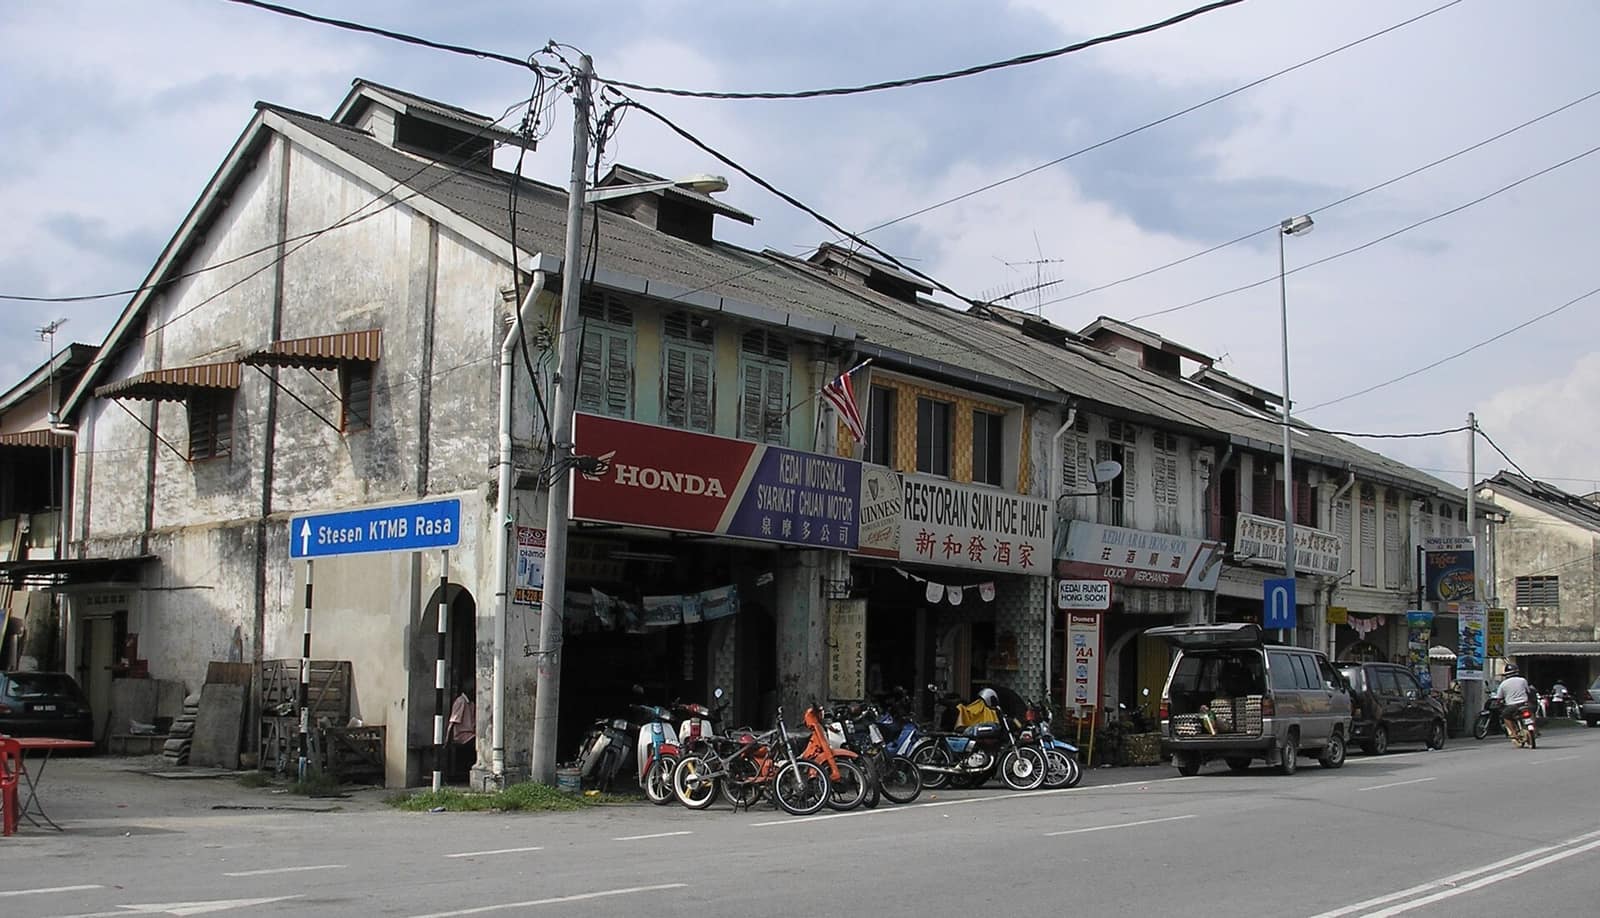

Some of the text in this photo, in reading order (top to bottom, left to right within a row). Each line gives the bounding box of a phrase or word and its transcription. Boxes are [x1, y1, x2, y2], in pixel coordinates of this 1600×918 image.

[614, 463, 726, 498] HONDA
[779, 453, 802, 485] KEDAI
[757, 484, 853, 522] SYARIKAT CHUAN MOTOR
[861, 498, 902, 524] UINNESS
[903, 481, 968, 528] RESTORAN
[971, 492, 992, 531] SUN
[994, 496, 1017, 535] HOE
[1020, 500, 1048, 539] HUAT
[318, 516, 451, 544] Stesen KTMB Rasa
[761, 515, 849, 545] 泉摩多公司
[915, 528, 1034, 568] 新和發酒家
[1060, 584, 1108, 593] KEDAI RUNCIT
[1133, 570, 1170, 584] MERCHANTS
[1084, 594, 1106, 602] SOON
